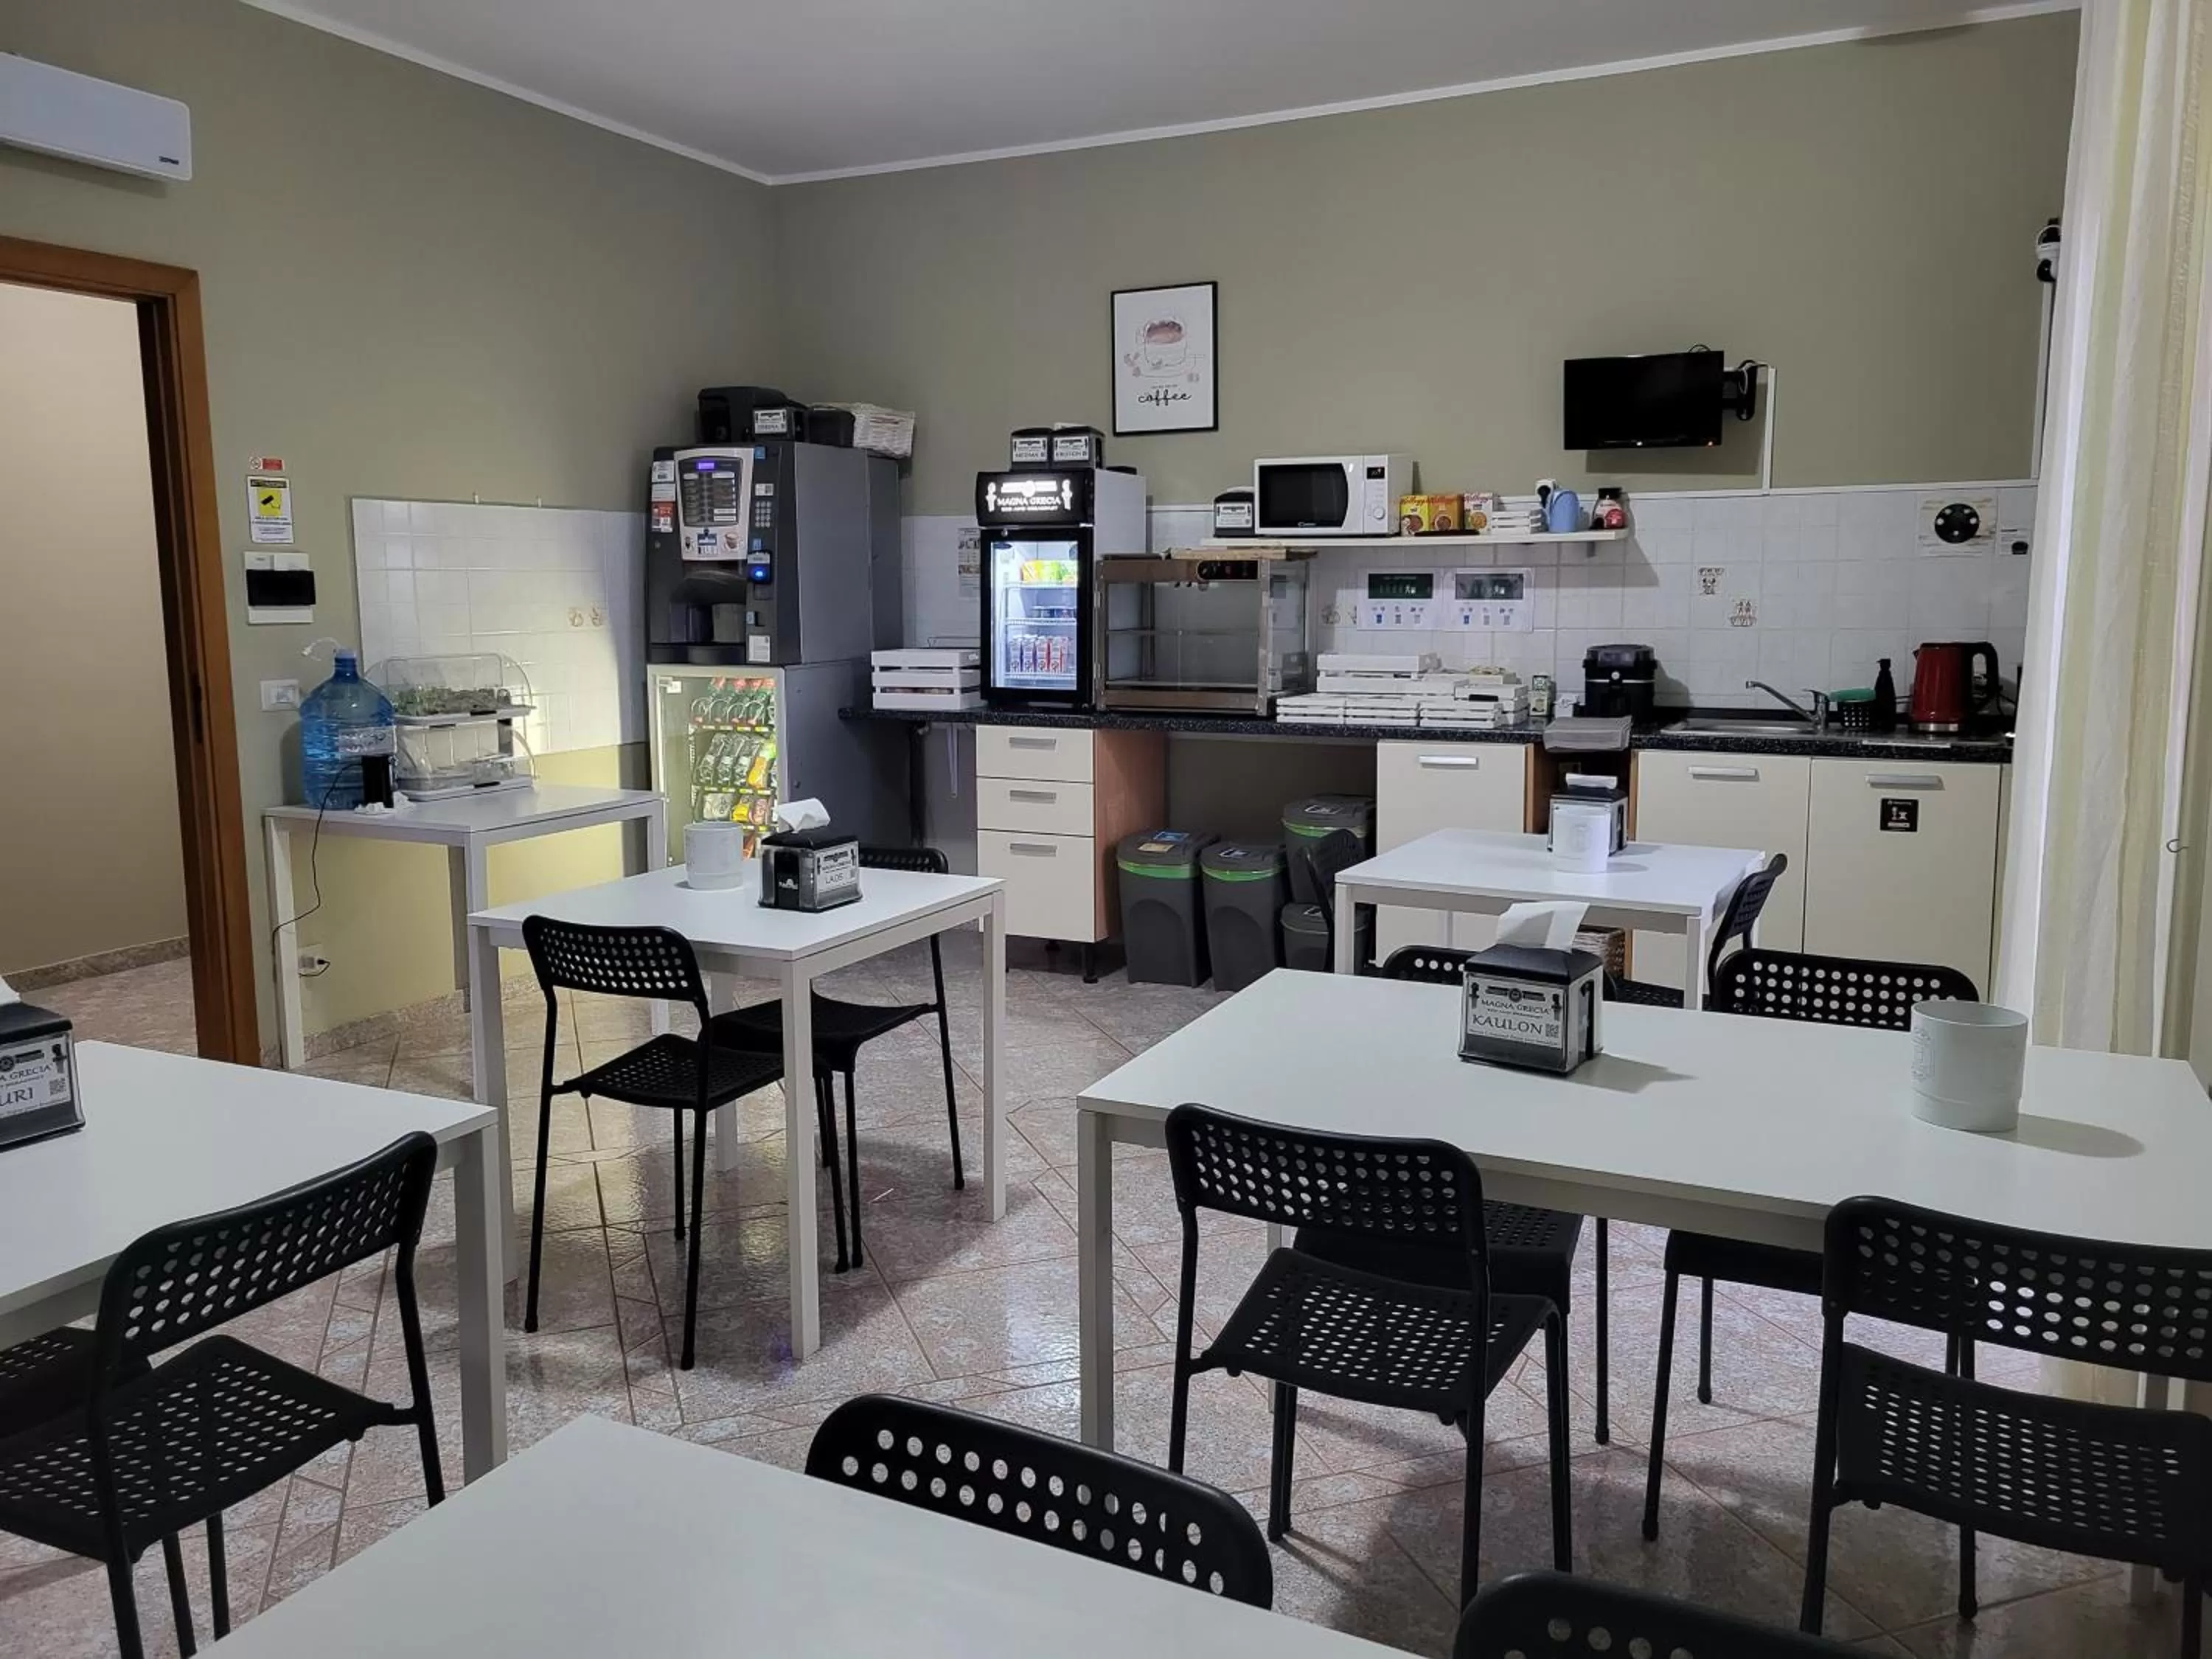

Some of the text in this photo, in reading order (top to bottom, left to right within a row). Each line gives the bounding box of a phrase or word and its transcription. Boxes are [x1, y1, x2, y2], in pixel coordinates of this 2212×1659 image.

[1138, 389, 1193, 406] coffee
[996, 495, 1062, 507] MAGNA GRECIA
[1481, 998, 1514, 1009] MAGNA
[1517, 1004, 1551, 1015] GRECIA
[1472, 1013, 1544, 1035] KAULON
[9, 1064, 52, 1079] GRECIA
